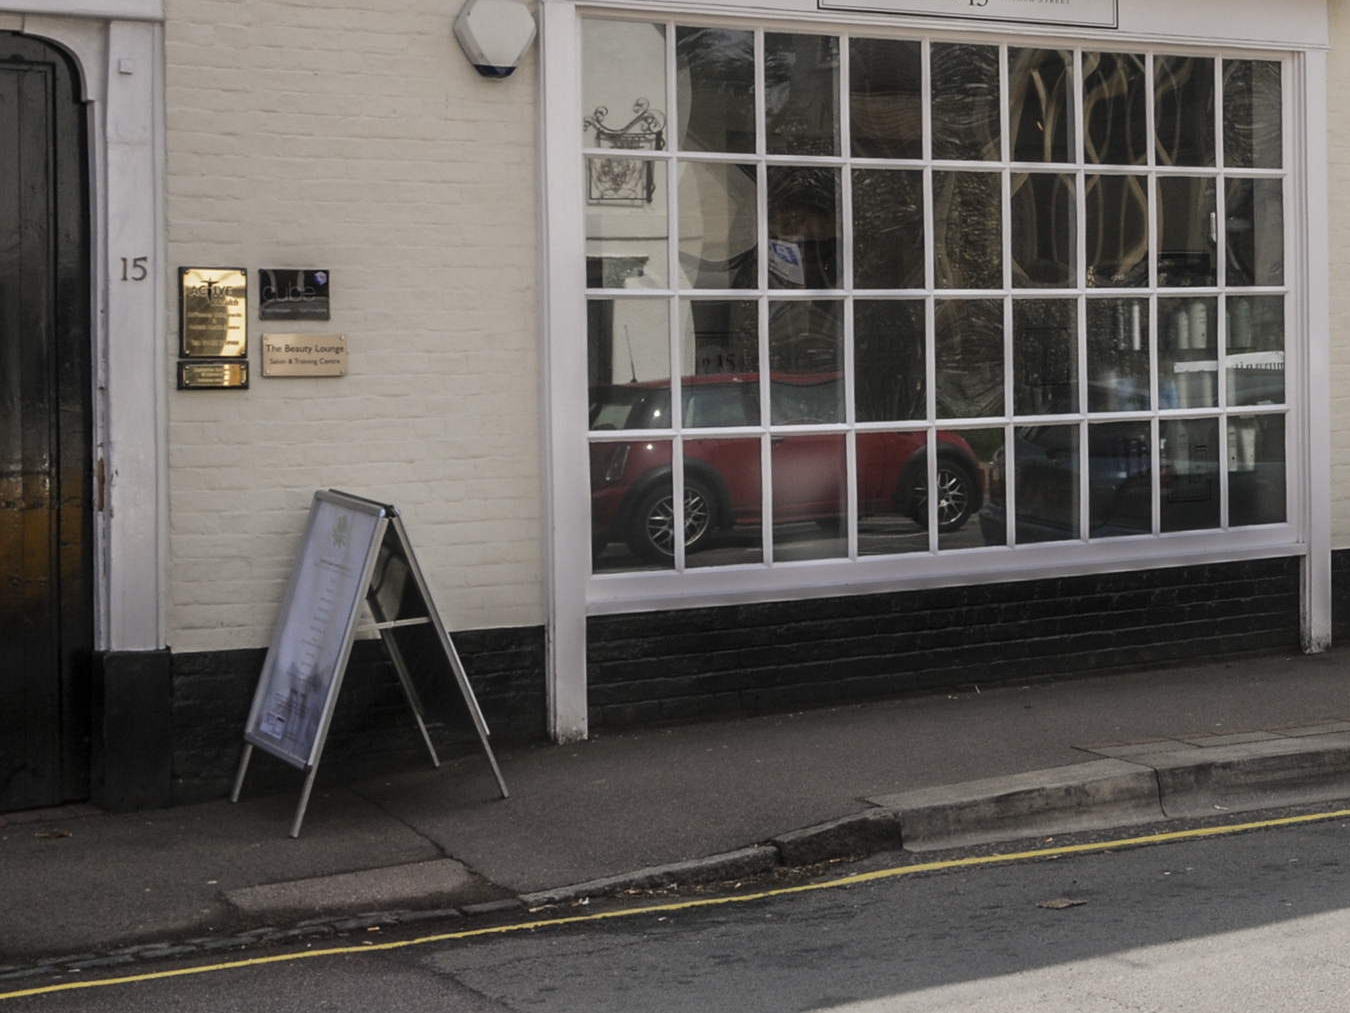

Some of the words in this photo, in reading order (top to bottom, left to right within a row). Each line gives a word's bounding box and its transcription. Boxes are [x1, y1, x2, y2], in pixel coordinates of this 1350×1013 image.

[120, 256, 148, 282] 15
[262, 281, 316, 302] cube
[266, 344, 282, 353] The
[284, 344, 313, 355] Beauty
[314, 344, 345, 355] Lounge
